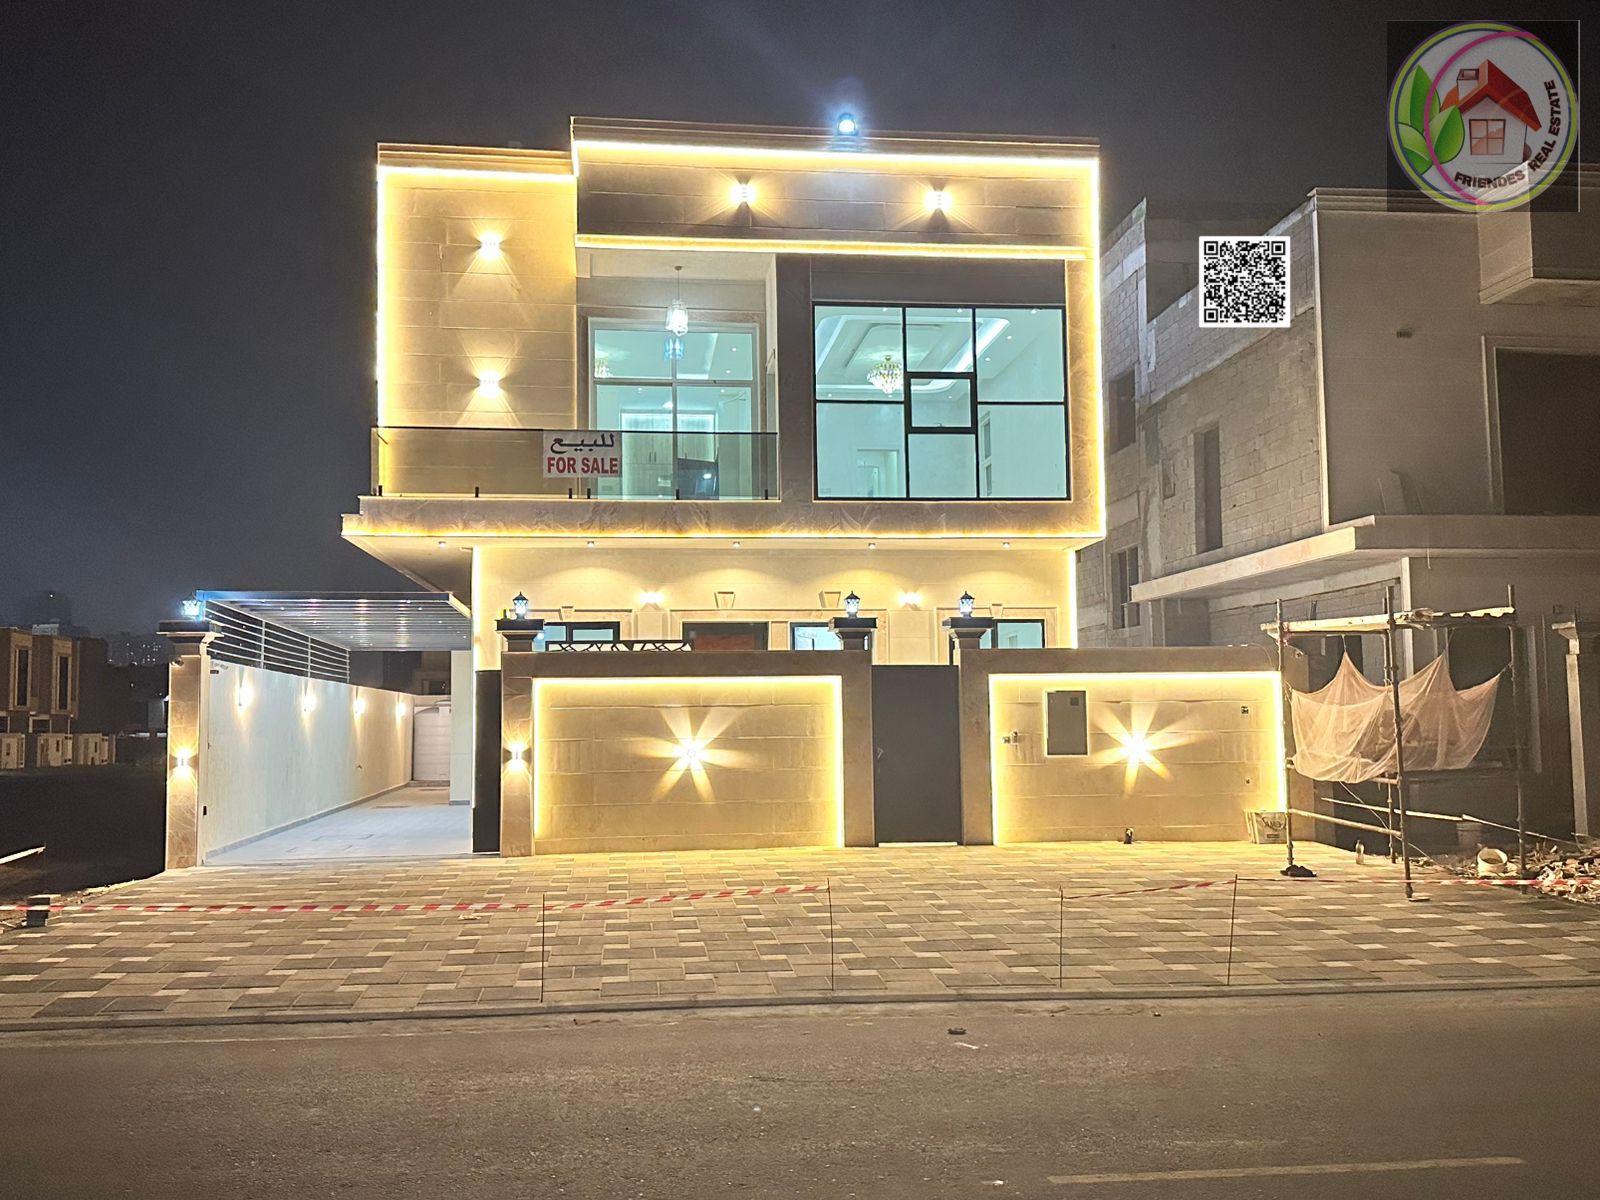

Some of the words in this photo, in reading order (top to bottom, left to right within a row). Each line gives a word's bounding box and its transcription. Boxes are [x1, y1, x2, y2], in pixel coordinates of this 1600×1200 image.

[550, 433, 615, 454] للبيع
[547, 457, 576, 473] FOR
[581, 457, 618, 474] SALE
